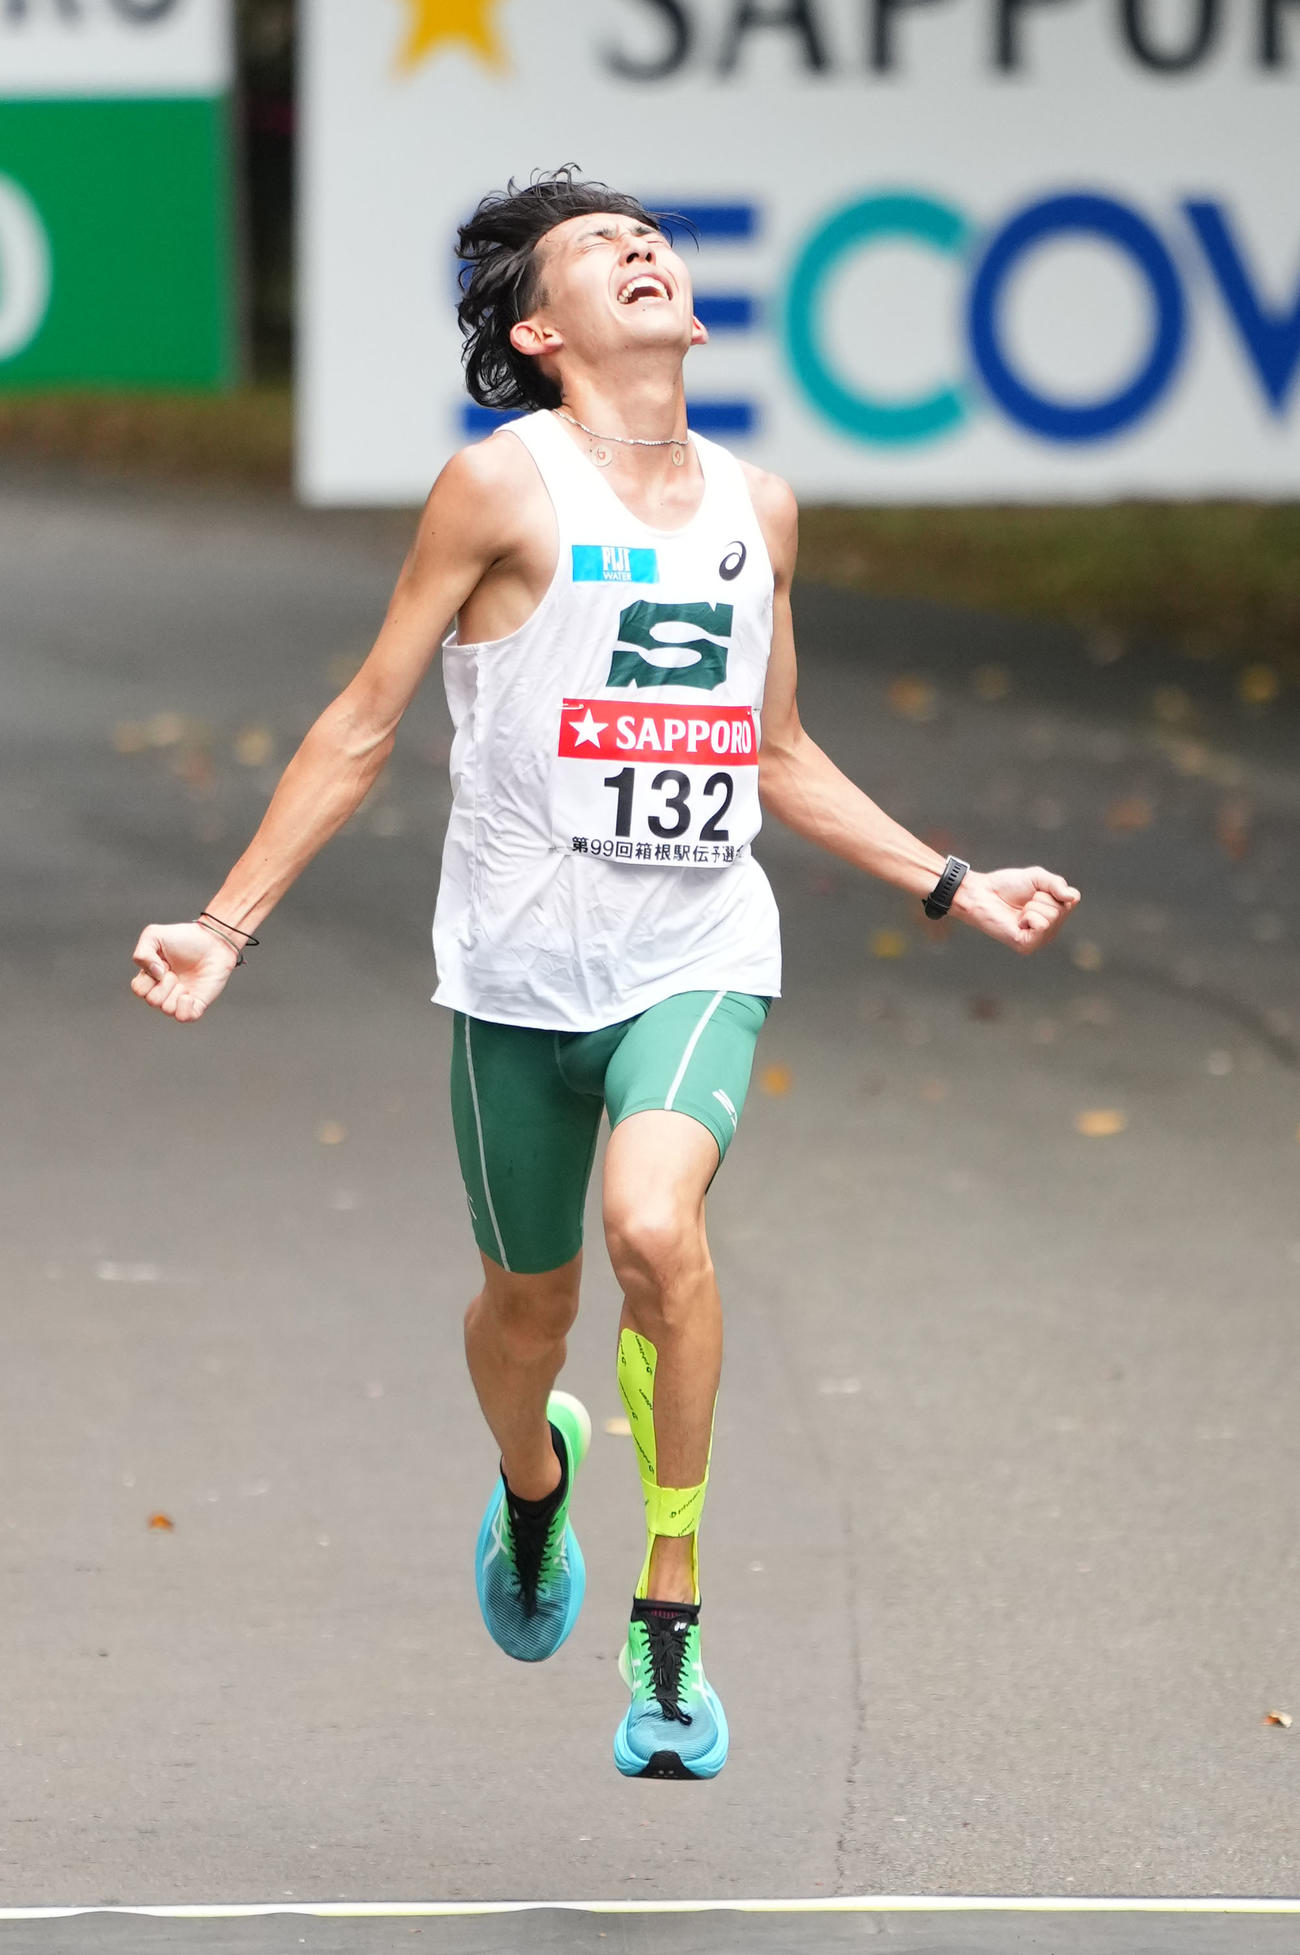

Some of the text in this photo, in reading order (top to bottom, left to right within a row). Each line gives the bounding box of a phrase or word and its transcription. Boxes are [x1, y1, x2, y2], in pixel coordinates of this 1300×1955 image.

[602, 571, 633, 581] WATER
[615, 715, 752, 755] SAPPORO
[603, 767, 734, 842] 132
[571, 836, 744, 864] 第99回箱根駅伝予選
